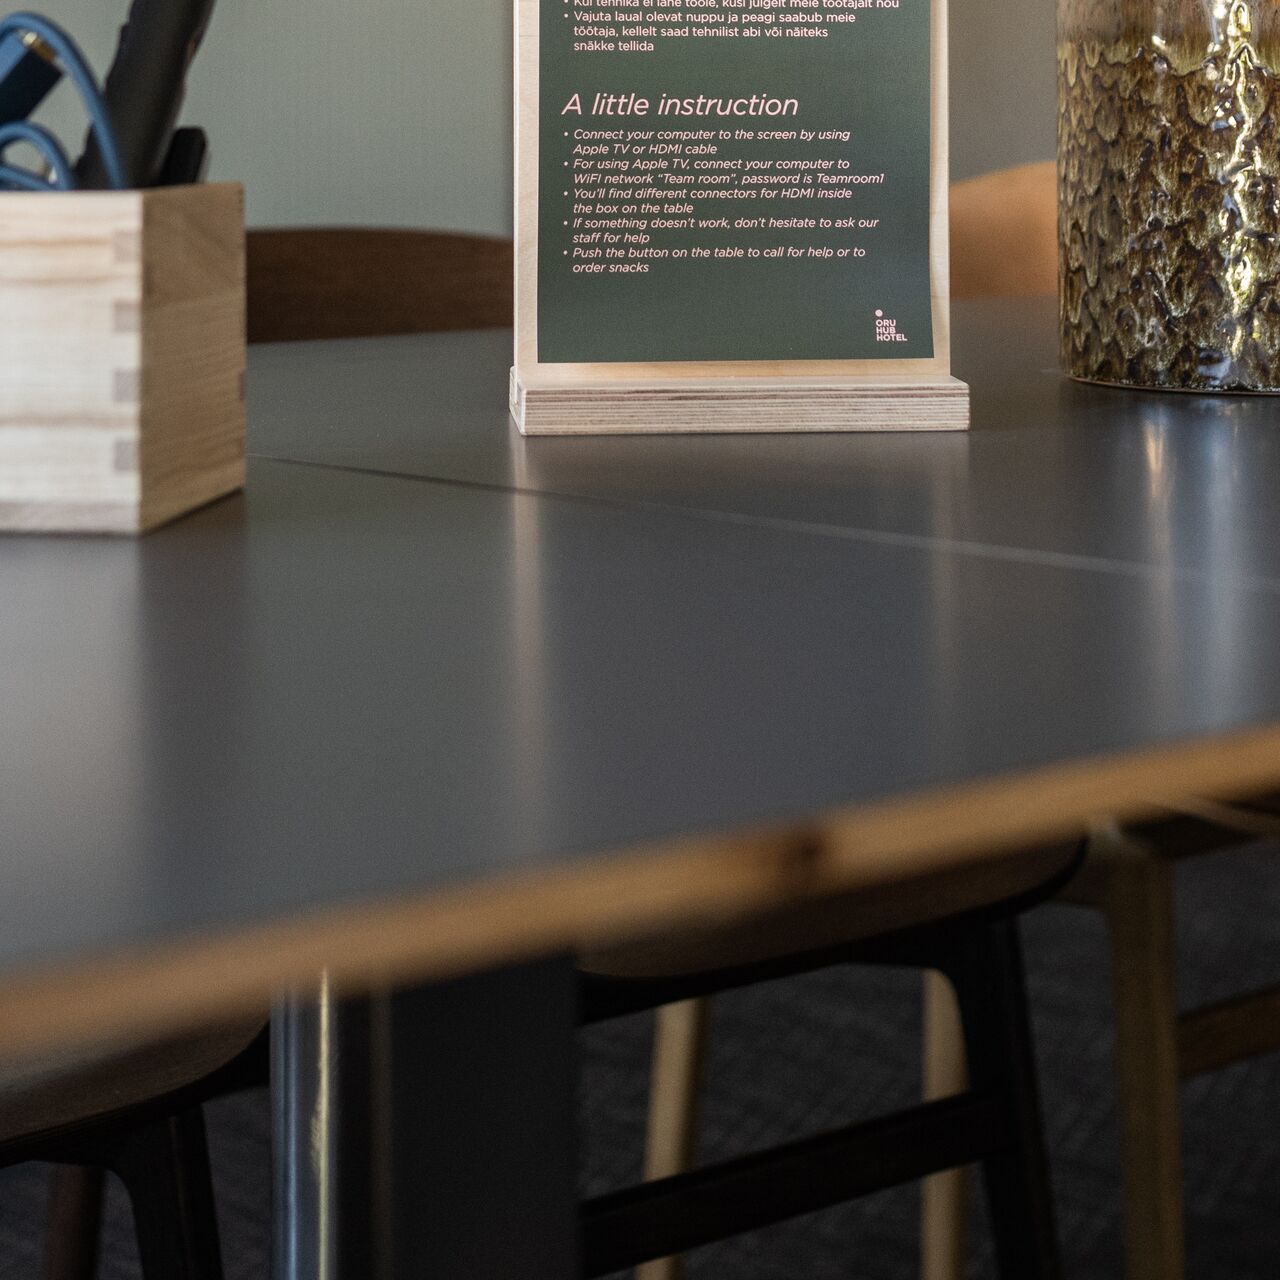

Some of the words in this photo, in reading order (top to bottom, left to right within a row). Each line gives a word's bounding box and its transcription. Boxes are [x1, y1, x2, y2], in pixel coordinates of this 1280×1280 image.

[573, 10, 612, 24] Vajuta
[614, 10, 643, 22] laual
[645, 10, 683, 23] olevat
[685, 13, 725, 24] nuppu
[727, 11, 739, 24] ja
[741, 11, 776, 25] peagi
[778, 11, 824, 23] saabub
[826, 11, 856, 23] meie
[622, 25, 658, 37] kellelt
[660, 25, 689, 38] saad
[691, 25, 740, 38] tehnilist
[742, 26, 761, 38] abi
[764, 26, 783, 38] või
[785, 26, 829, 38] näiteks
[573, 40, 616, 52] snäkke
[617, 40, 655, 52] tellida
[560, 93, 583, 116] A
[591, 92, 650, 116] little
[657, 92, 799, 116] instruction
[573, 128, 625, 140] Connect
[625, 130, 656, 142] your
[656, 129, 717, 142] computer
[718, 129, 732, 140] to
[734, 128, 755, 140] the
[756, 130, 797, 140] screen
[799, 128, 816, 142] by
[817, 128, 851, 142] using
[572, 143, 610, 156] Apple
[613, 143, 631, 155] TV
[631, 145, 647, 155] or
[648, 143, 683, 155] HDMI
[684, 143, 718, 155] cable
[572, 158, 595, 170] For
[596, 158, 630, 171] using
[631, 157, 669, 171] Apple
[672, 158, 690, 170] TV,
[693, 158, 743, 170] connect
[744, 160, 774, 171] your
[775, 158, 835, 171] computer
[836, 158, 851, 170] to
[604, 172, 655, 184] network
[741, 172, 801, 186] password
[802, 173, 813, 184] is
[816, 172, 885, 184] Teamroom1
[608, 187, 633, 199] find
[634, 187, 688, 199] different
[689, 188, 758, 199] connectors
[760, 187, 779, 199] for
[780, 187, 815, 199] HDMI
[817, 187, 853, 199] inside
[573, 202, 593, 214] the
[595, 202, 620, 214] box
[621, 204, 638, 214] on
[640, 202, 661, 214] the
[663, 202, 694, 214] table
[572, 217, 583, 229] If
[583, 217, 648, 231] something
[698, 216, 731, 230] work,
[768, 217, 817, 229] hesitate
[819, 217, 833, 228] to
[834, 216, 856, 228] ask
[857, 219, 880, 228] our
[572, 232, 602, 244] staff
[603, 231, 622, 244] for
[623, 231, 650, 245] help
[572, 247, 603, 259] Push
[605, 247, 626, 258] the
[627, 246, 669, 258] button
[671, 248, 688, 258] on
[691, 246, 711, 258] the
[713, 246, 745, 258] table
[747, 247, 761, 258] to
[762, 246, 785, 258] call
[786, 246, 806, 258] for
[807, 245, 834, 259] help
[836, 248, 851, 258] or
[853, 247, 866, 258] to
[572, 261, 607, 273] order
[608, 261, 650, 273] snacks
[876, 319, 896, 327] ORU
[876, 326, 896, 334] HUB
[876, 333, 908, 342] HOTEL
